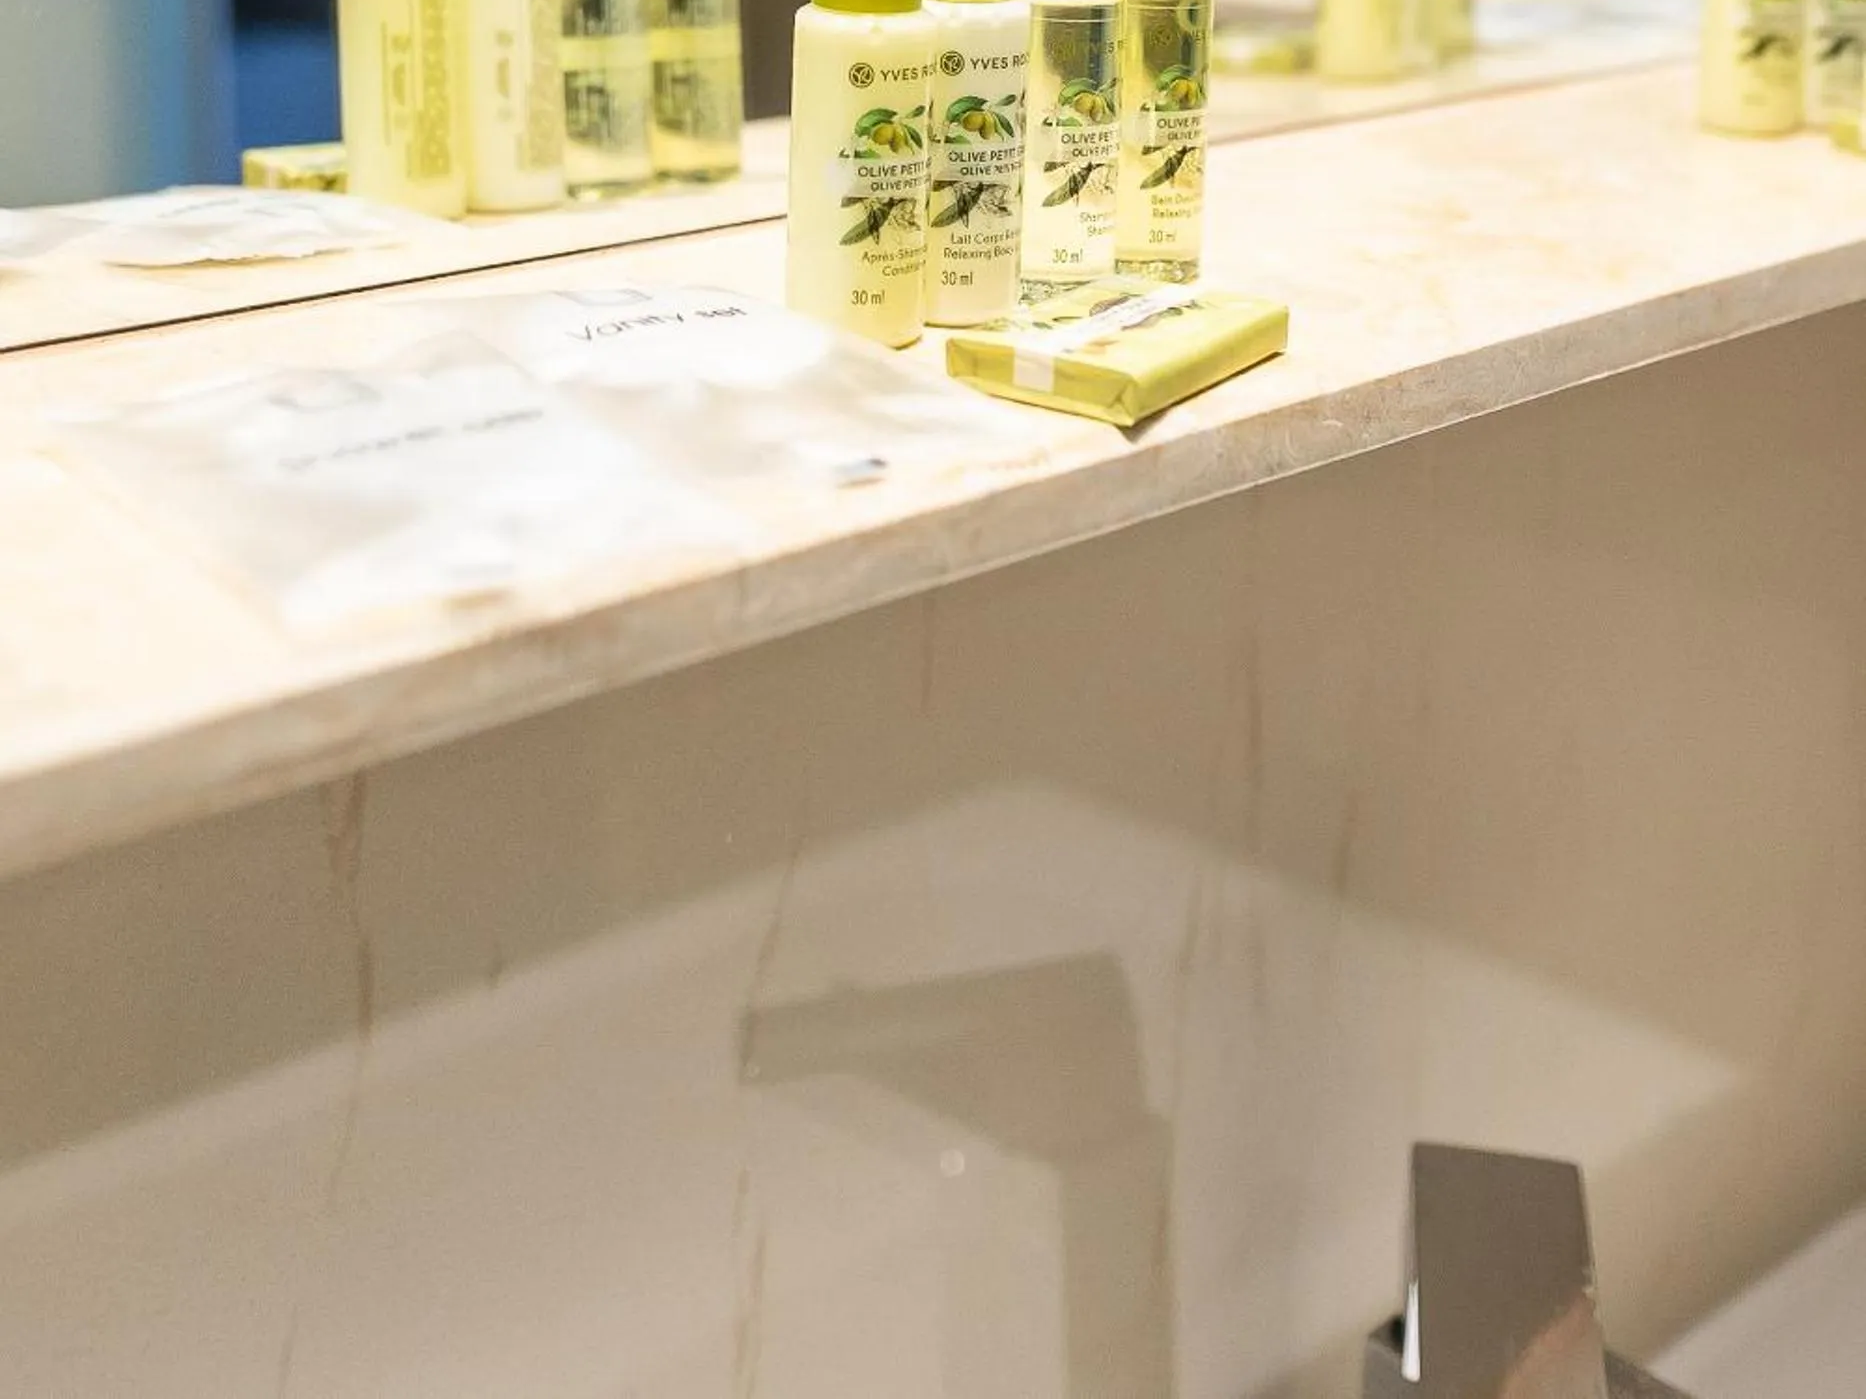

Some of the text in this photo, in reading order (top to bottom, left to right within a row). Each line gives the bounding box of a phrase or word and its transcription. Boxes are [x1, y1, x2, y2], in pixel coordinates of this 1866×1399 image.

[969, 57, 1009, 70] YVES
[880, 67, 919, 82] YVES
[1157, 117, 1189, 129] OLIVE
[1061, 133, 1096, 144] OLIVE
[949, 150, 988, 162] OLIVE
[858, 164, 898, 178] OLIVE
[960, 165, 991, 176] OLIVE
[871, 180, 902, 192] OLIVE
[1149, 229, 1163, 243] 30
[943, 247, 991, 261] Relaxing
[941, 271, 973, 286] 30 ml
[851, 290, 885, 305] 30 ml
[565, 305, 748, 342] Vanity set
